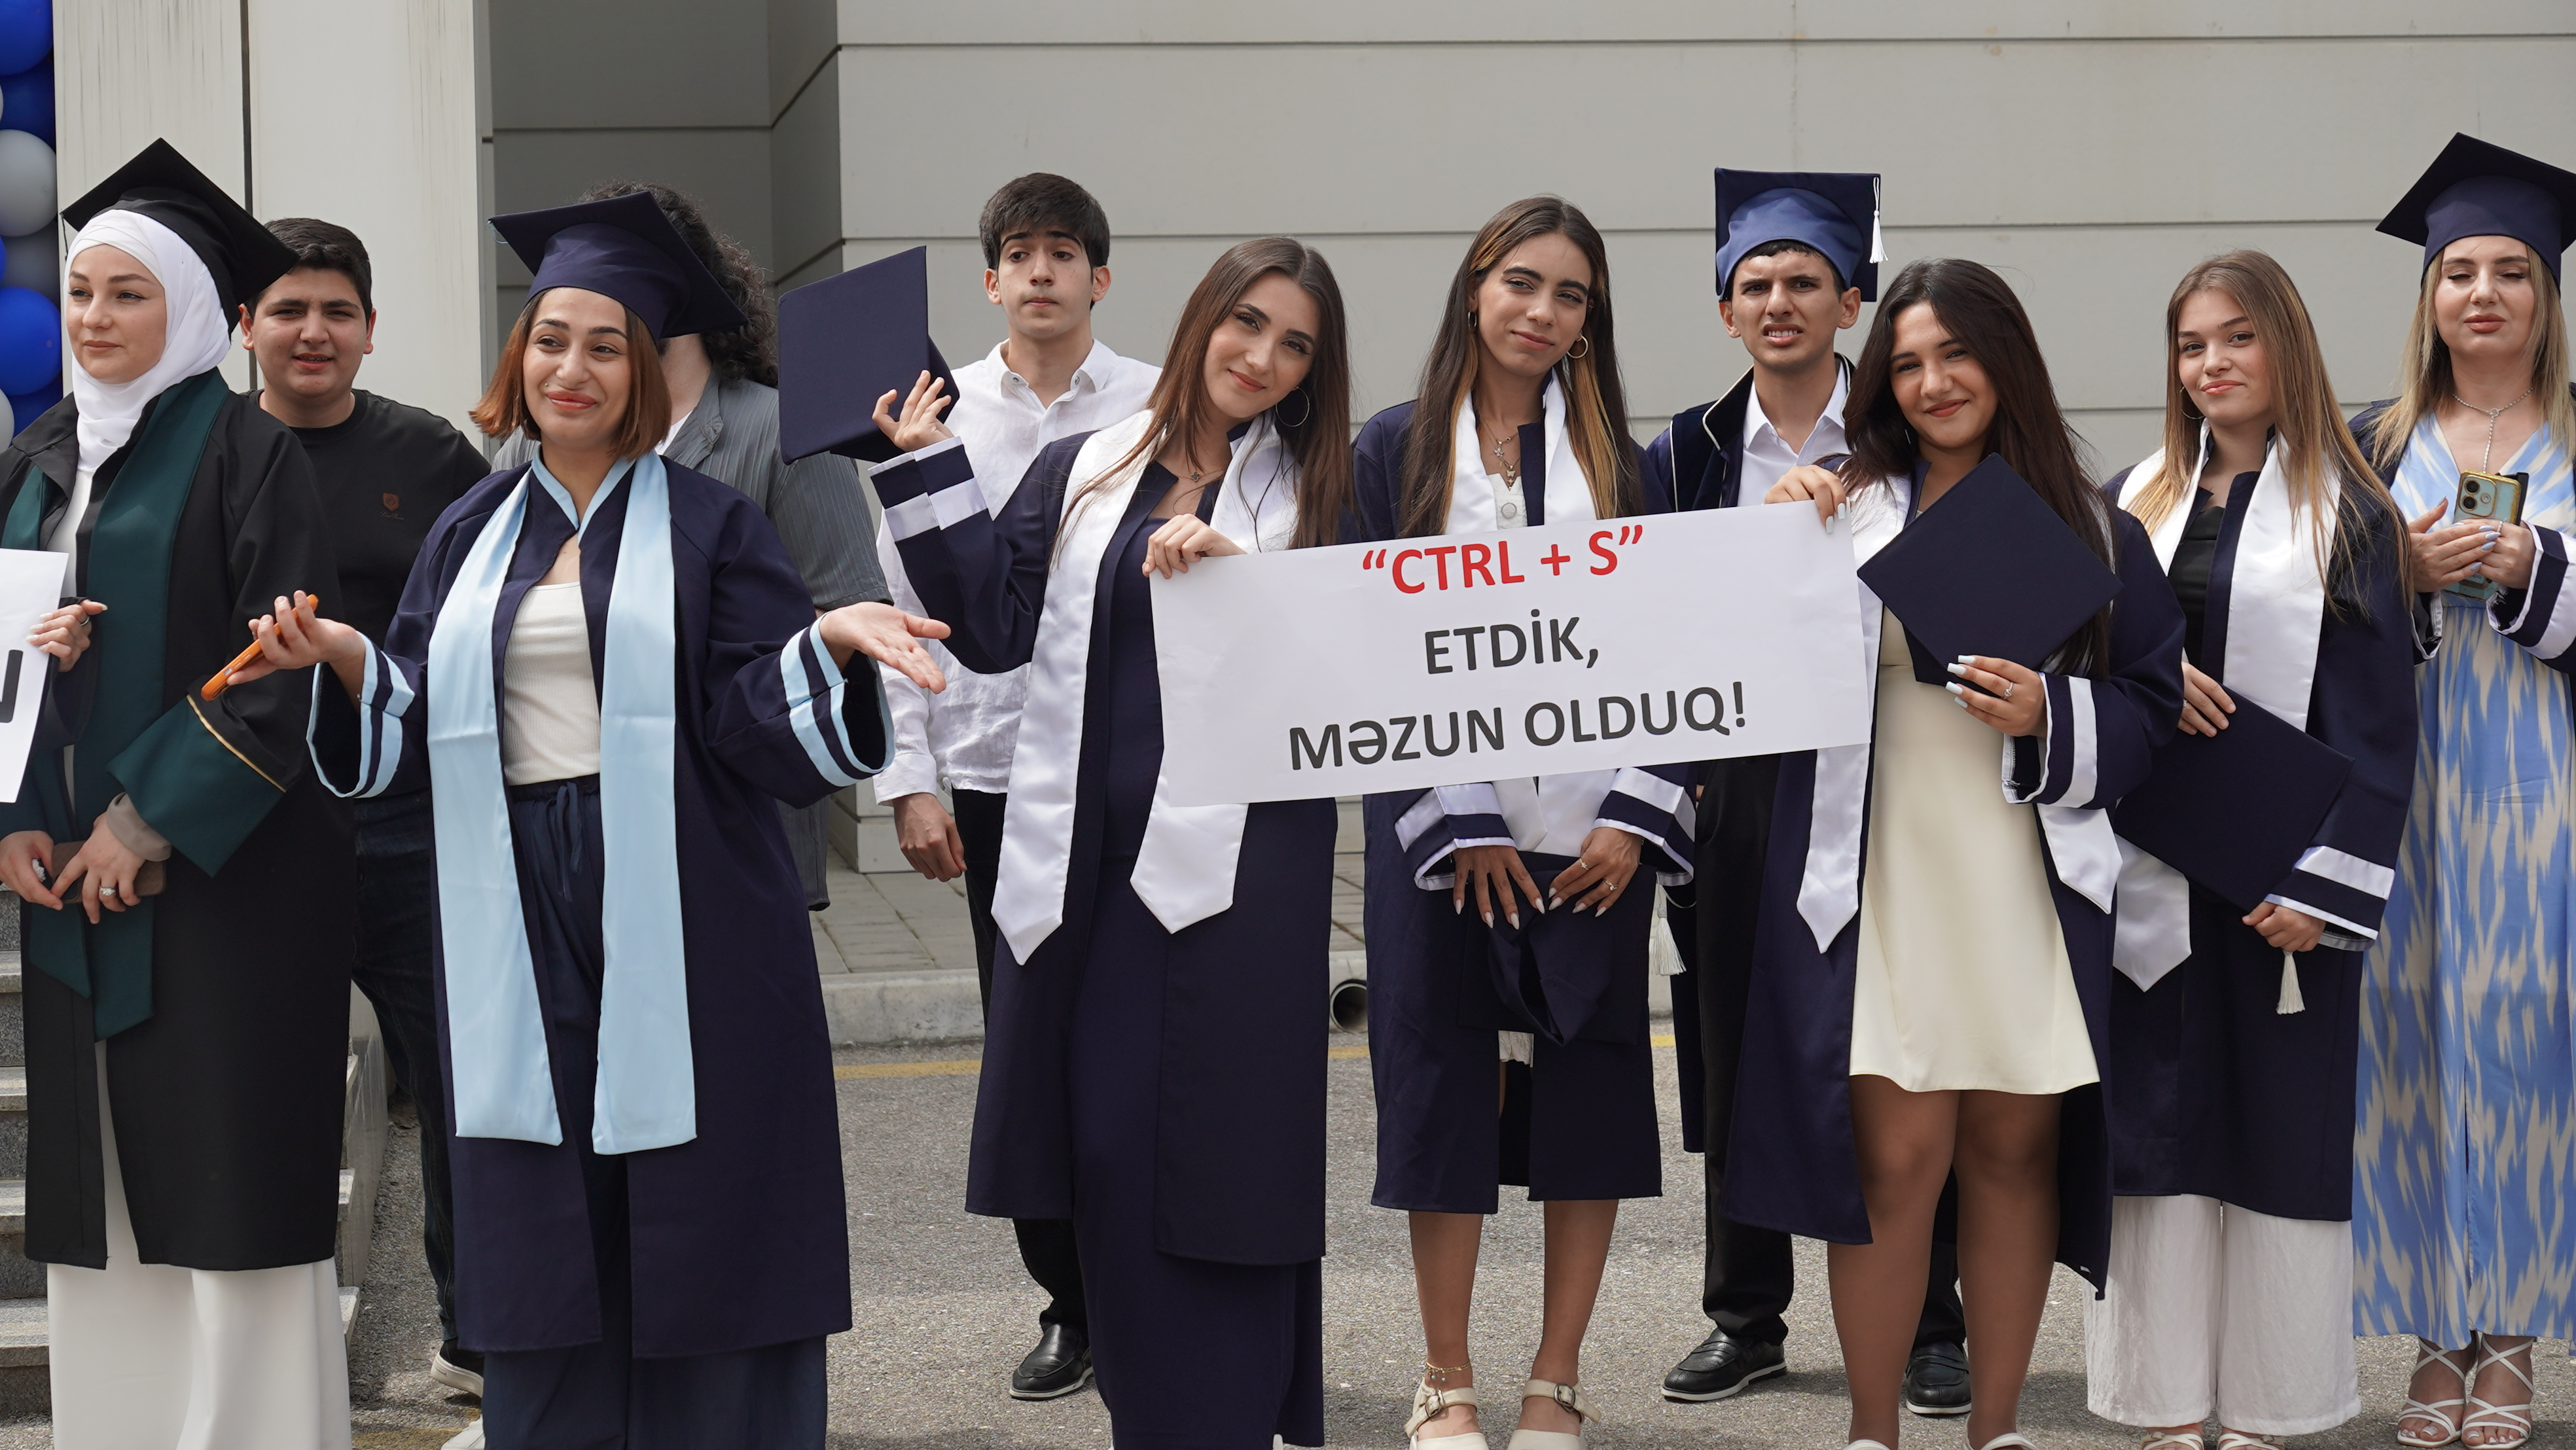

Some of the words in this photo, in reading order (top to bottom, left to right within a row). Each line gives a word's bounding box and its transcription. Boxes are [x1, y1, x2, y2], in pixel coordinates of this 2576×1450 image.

[1362, 540, 1526, 595] “CTRL
[1540, 543, 1571, 577] +
[1588, 523, 1643, 576] S”
[1424, 608, 1600, 675] ETDİK,
[1289, 706, 1505, 771] MƏZUN
[1524, 681, 1746, 747] OLDUQ!
